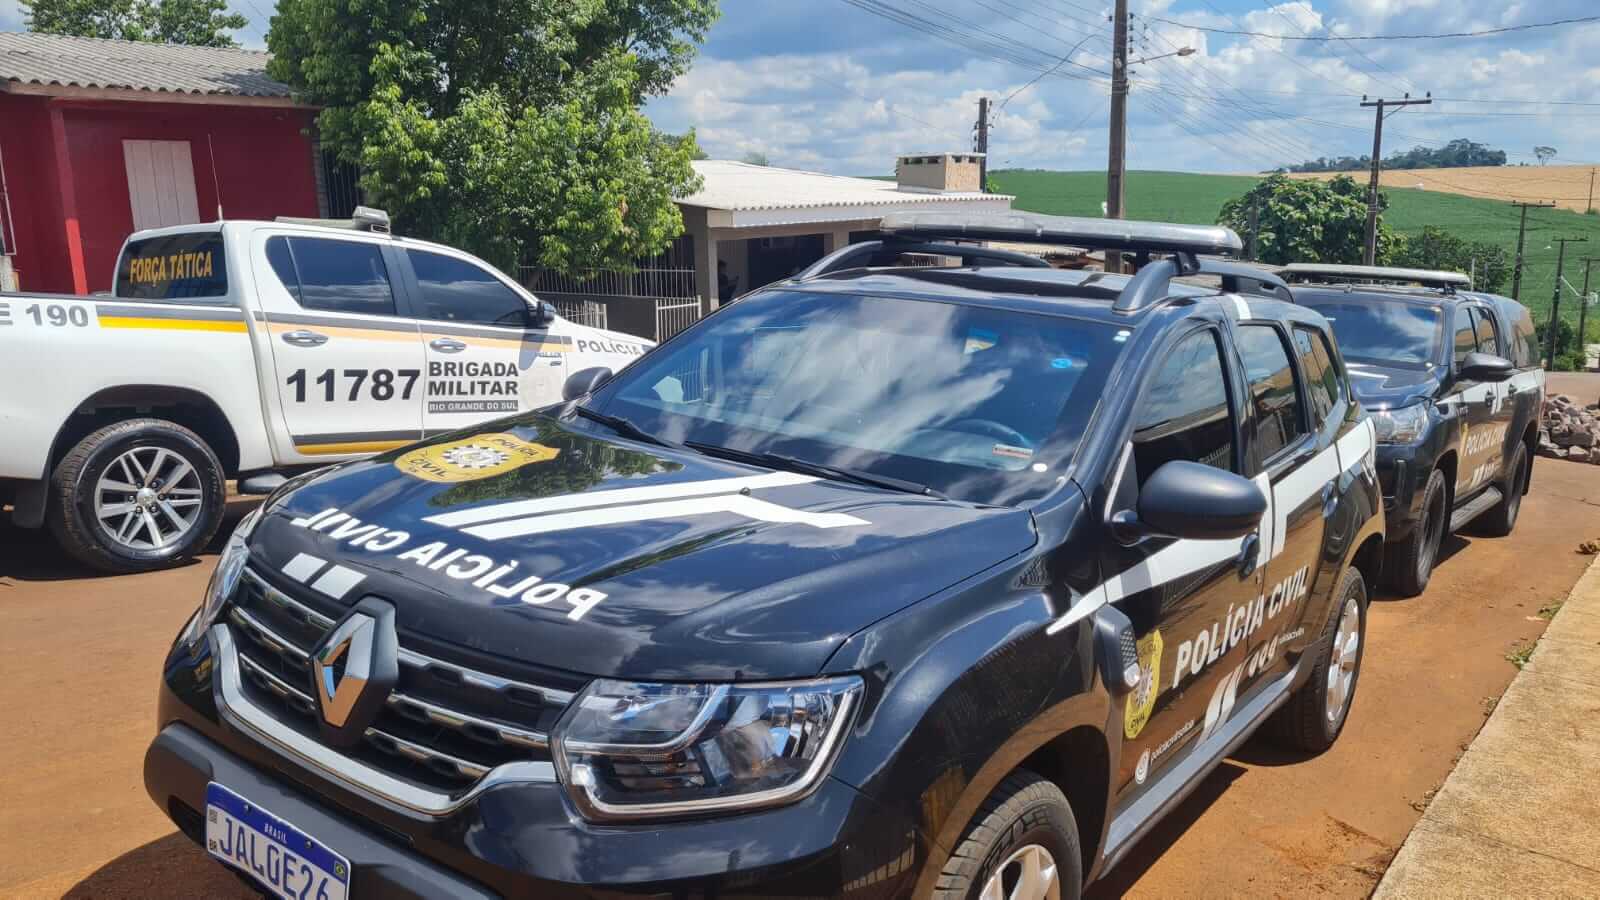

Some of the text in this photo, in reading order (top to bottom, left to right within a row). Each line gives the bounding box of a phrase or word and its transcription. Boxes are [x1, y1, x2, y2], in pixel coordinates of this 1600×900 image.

[129, 249, 213, 287] FORÇA TÁTICA
[25, 303, 89, 328] 190
[428, 361, 519, 377] BRIGADA
[286, 368, 421, 402] 11787
[428, 380, 519, 396] MILITAR
[429, 401, 518, 411] RIO GRANDE DO SUL
[410, 458, 449, 478] CIVIL
[1172, 593, 1265, 689] POLÍCIA
[1268, 565, 1309, 619] CIVIL
[264, 823, 287, 844] BRASIL
